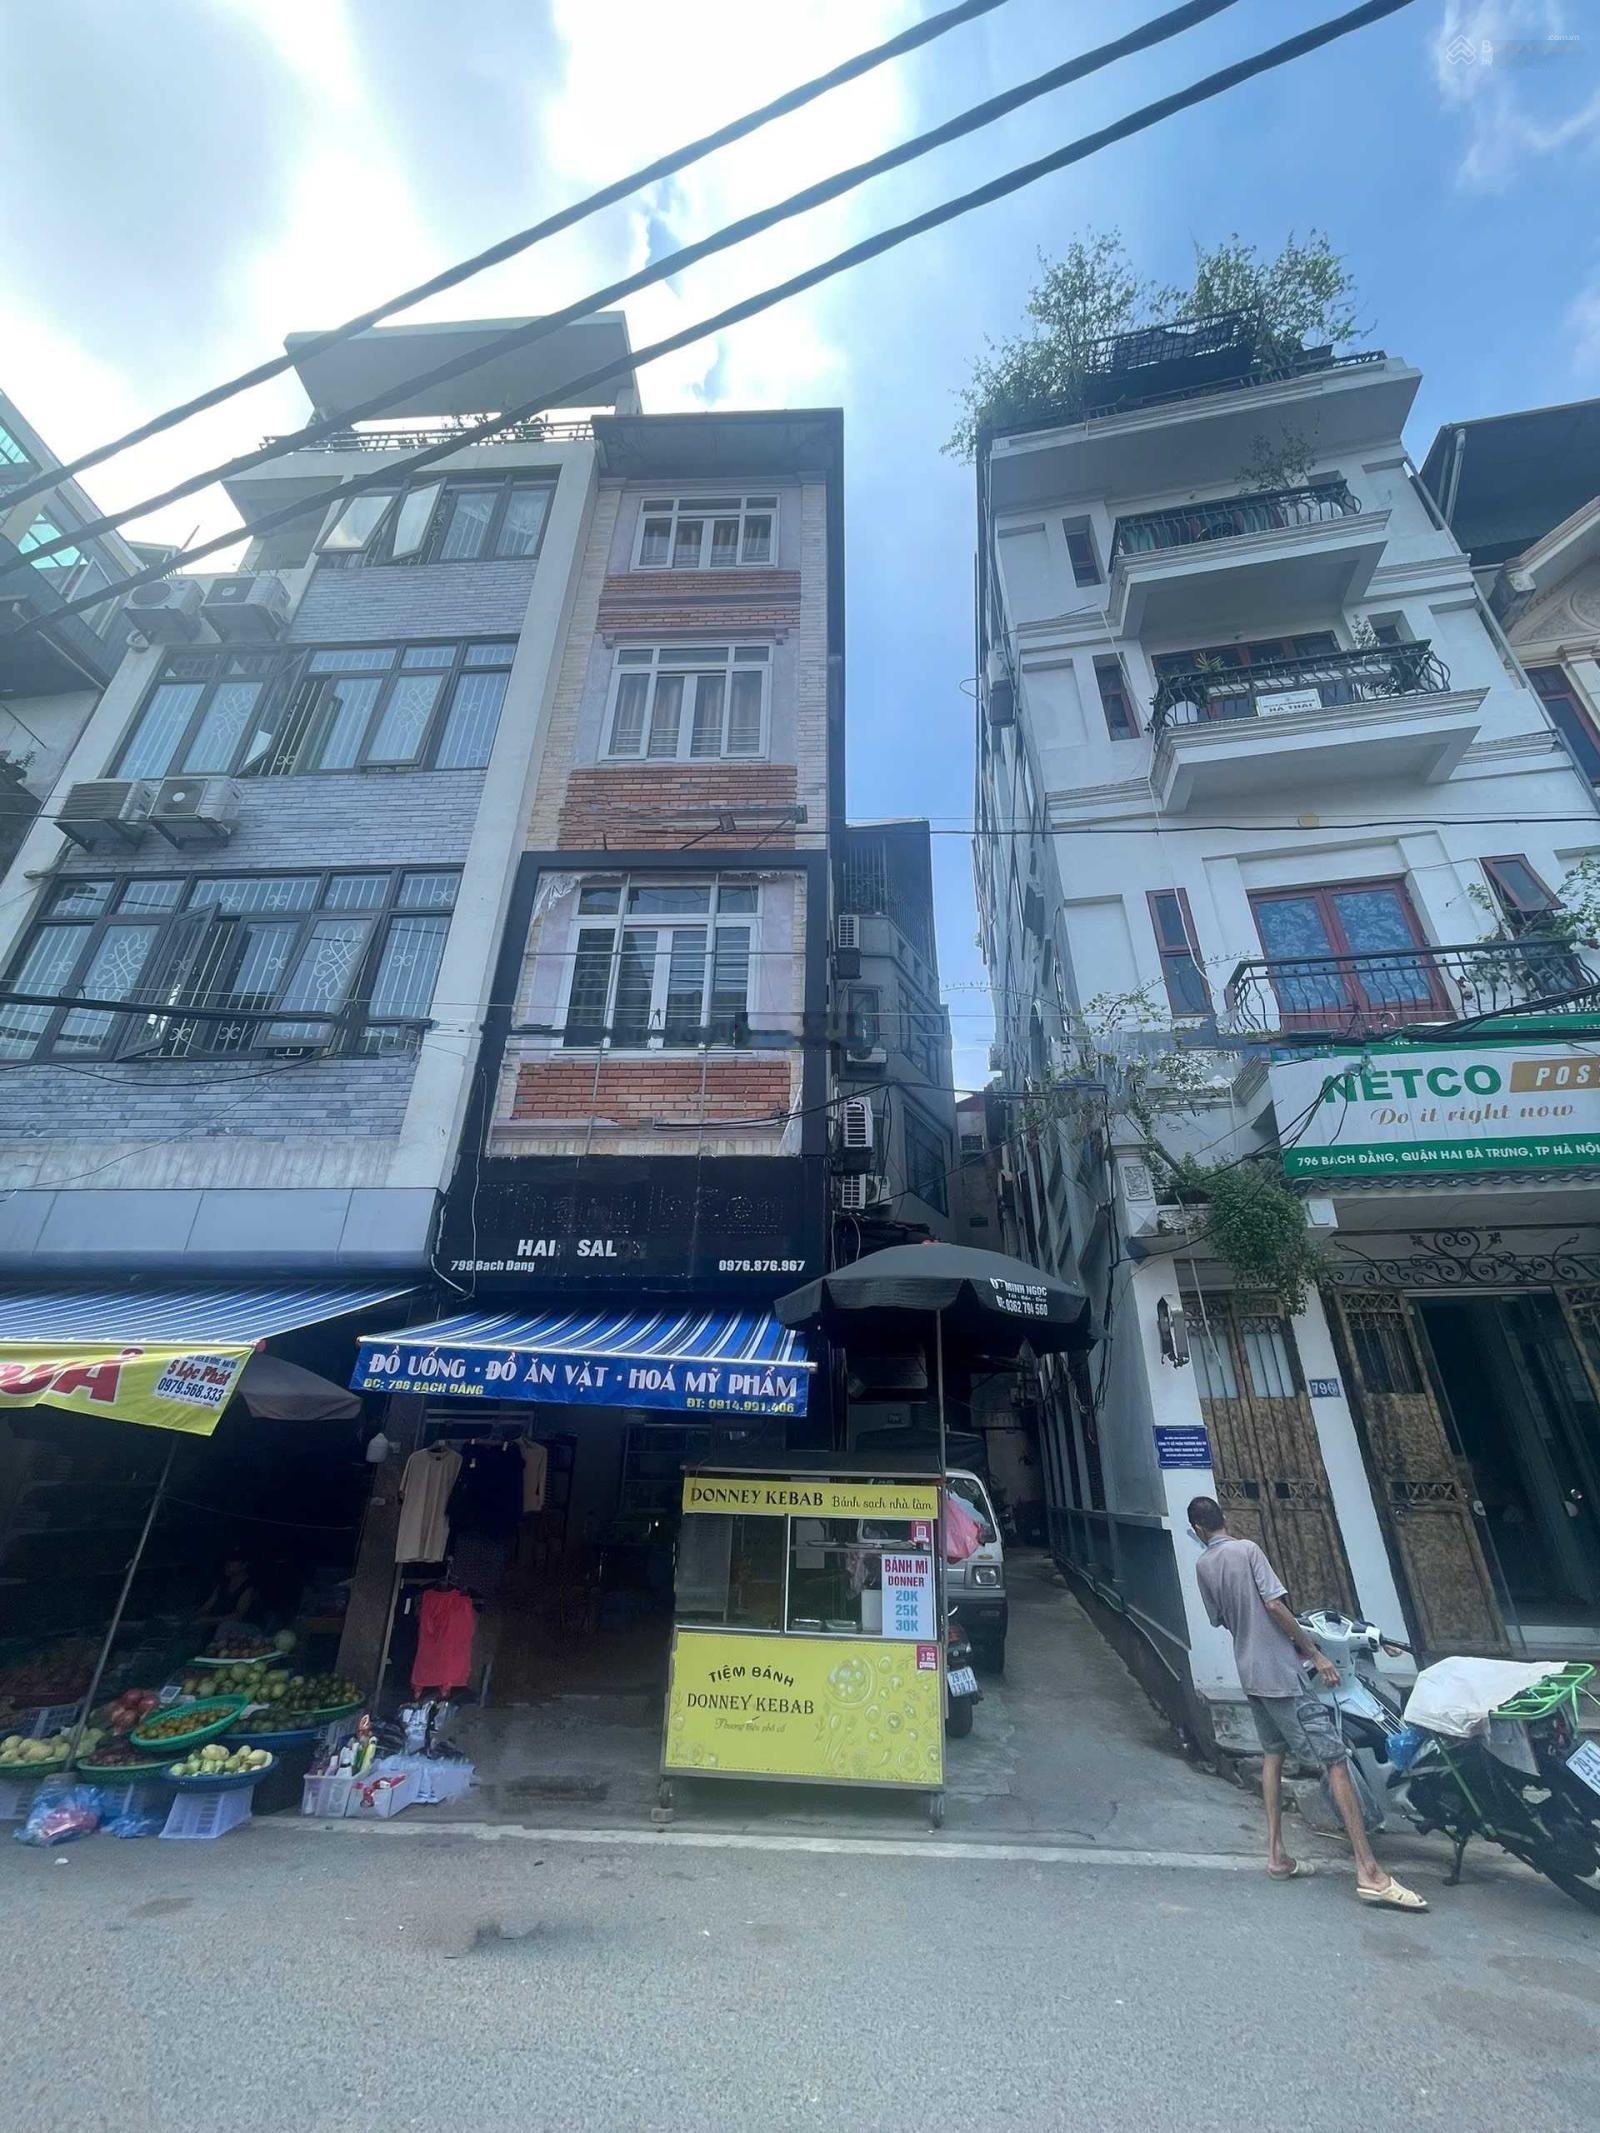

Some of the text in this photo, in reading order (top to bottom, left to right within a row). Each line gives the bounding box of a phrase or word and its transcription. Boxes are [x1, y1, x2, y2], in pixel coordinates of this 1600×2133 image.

[1322, 1064, 1600, 1103] NETCO POS
[1371, 1103, 1574, 1126] Do it right now
[1297, 1157, 1319, 1167] 796
[1440, 1149, 1463, 1160] HAI
[1465, 1147, 1483, 1159] BÀ
[1485, 1146, 1533, 1158] TRƯNG,
[1535, 1146, 1550, 1156] TP
[1553, 1143, 1573, 1155] HÀ
[450, 1260, 535, 1272] 798 Bach Dang
[718, 1259, 806, 1272] 0976.876.967
[369, 1346, 797, 1397] ĐỒ UỐNG ĐỒ ĂN VẶT HOÁ MỸ PHẨM
[157, 1377, 224, 1402] 0979.568.333
[691, 1487, 761, 1504] DONNEY
[765, 1490, 823, 1506] KEBAB
[832, 1495, 860, 1508] Bánh
[889, 1497, 909, 1509] nhà
[884, 1556, 912, 1574] BÁNH
[888, 1575, 925, 1588] DONNER
[895, 1590, 918, 1602] 20K
[895, 1604, 918, 1617] 25K
[895, 1619, 919, 1632] 30K
[708, 1664, 795, 1688] TIỆM BÁNH
[687, 1693, 815, 1715] DONNEY KEBAB
